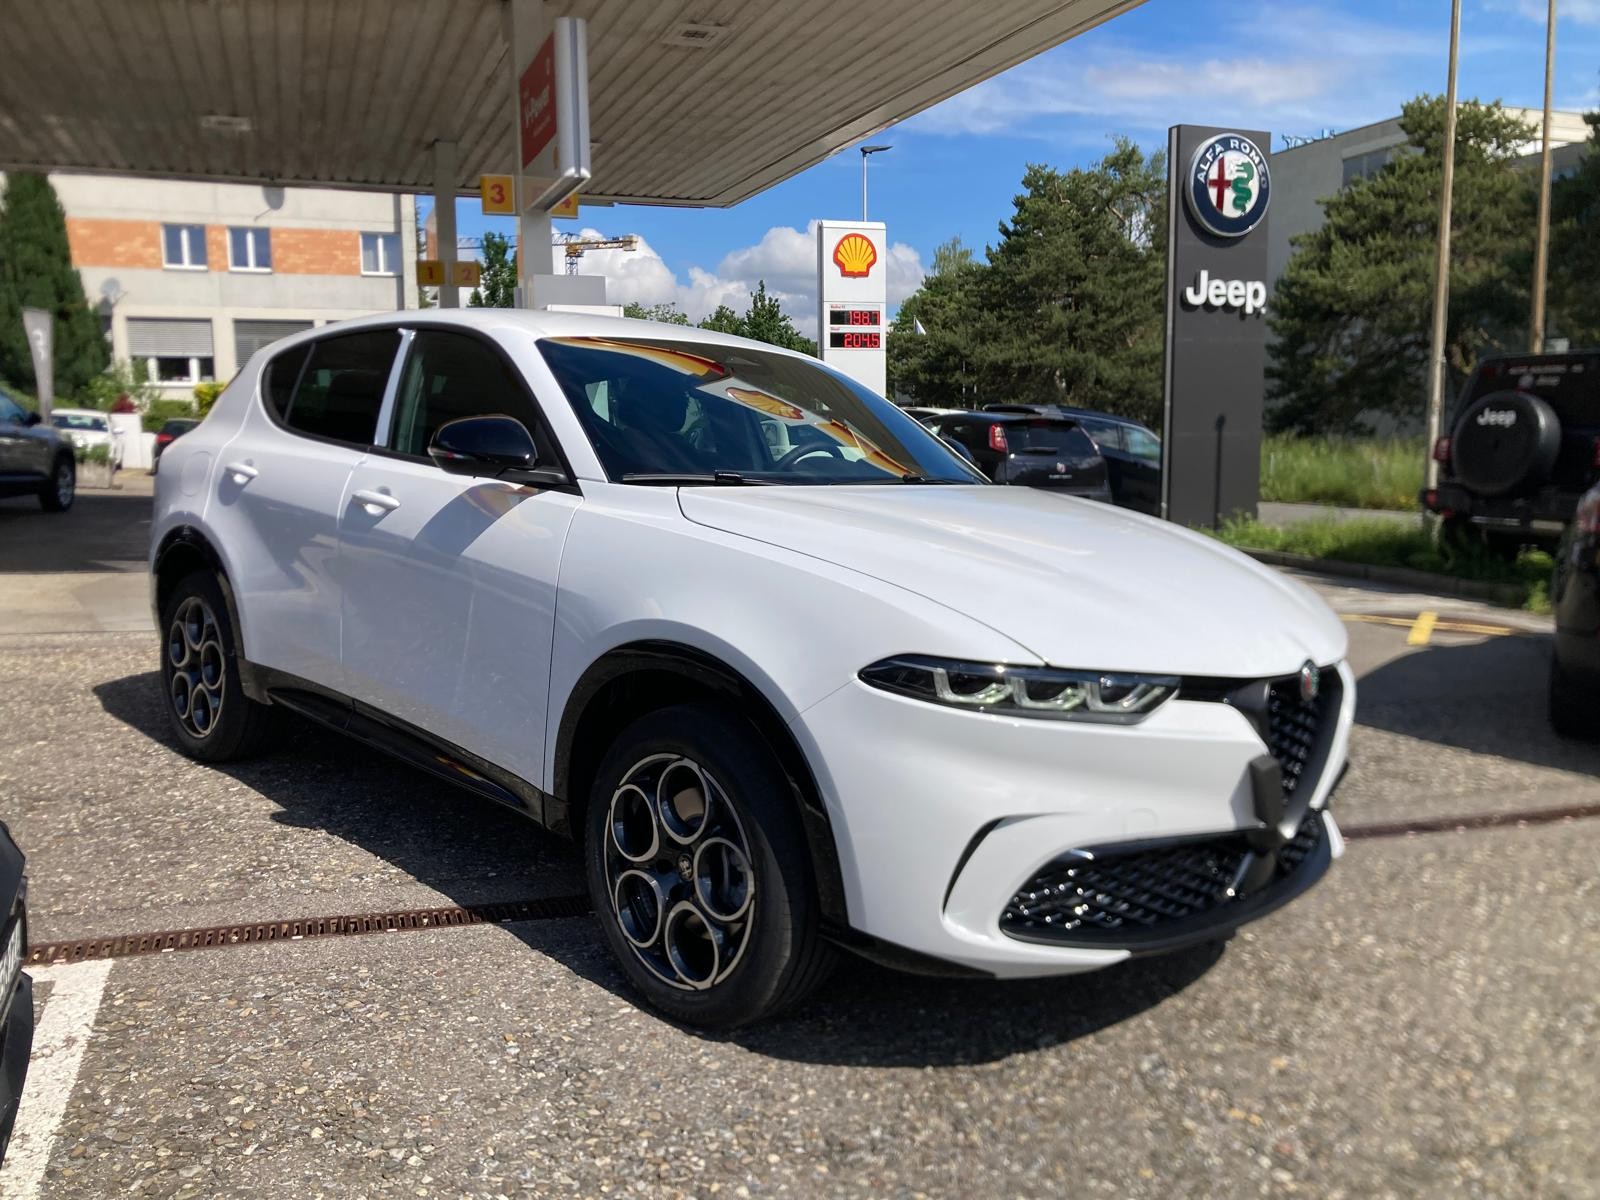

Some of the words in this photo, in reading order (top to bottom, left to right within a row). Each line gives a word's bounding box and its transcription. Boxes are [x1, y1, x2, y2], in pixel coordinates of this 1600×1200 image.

[1197, 142, 1225, 185] ALFA
[1229, 138, 1268, 190] ROMEO
[489, 183, 506, 205] 3
[427, 266, 434, 280] 1
[462, 268, 473, 281] 2
[1185, 269, 1266, 314] Jeep
[848, 310, 880, 325] 198.7
[844, 333, 880, 348] 204.5
[1476, 407, 1517, 428] Jeep
